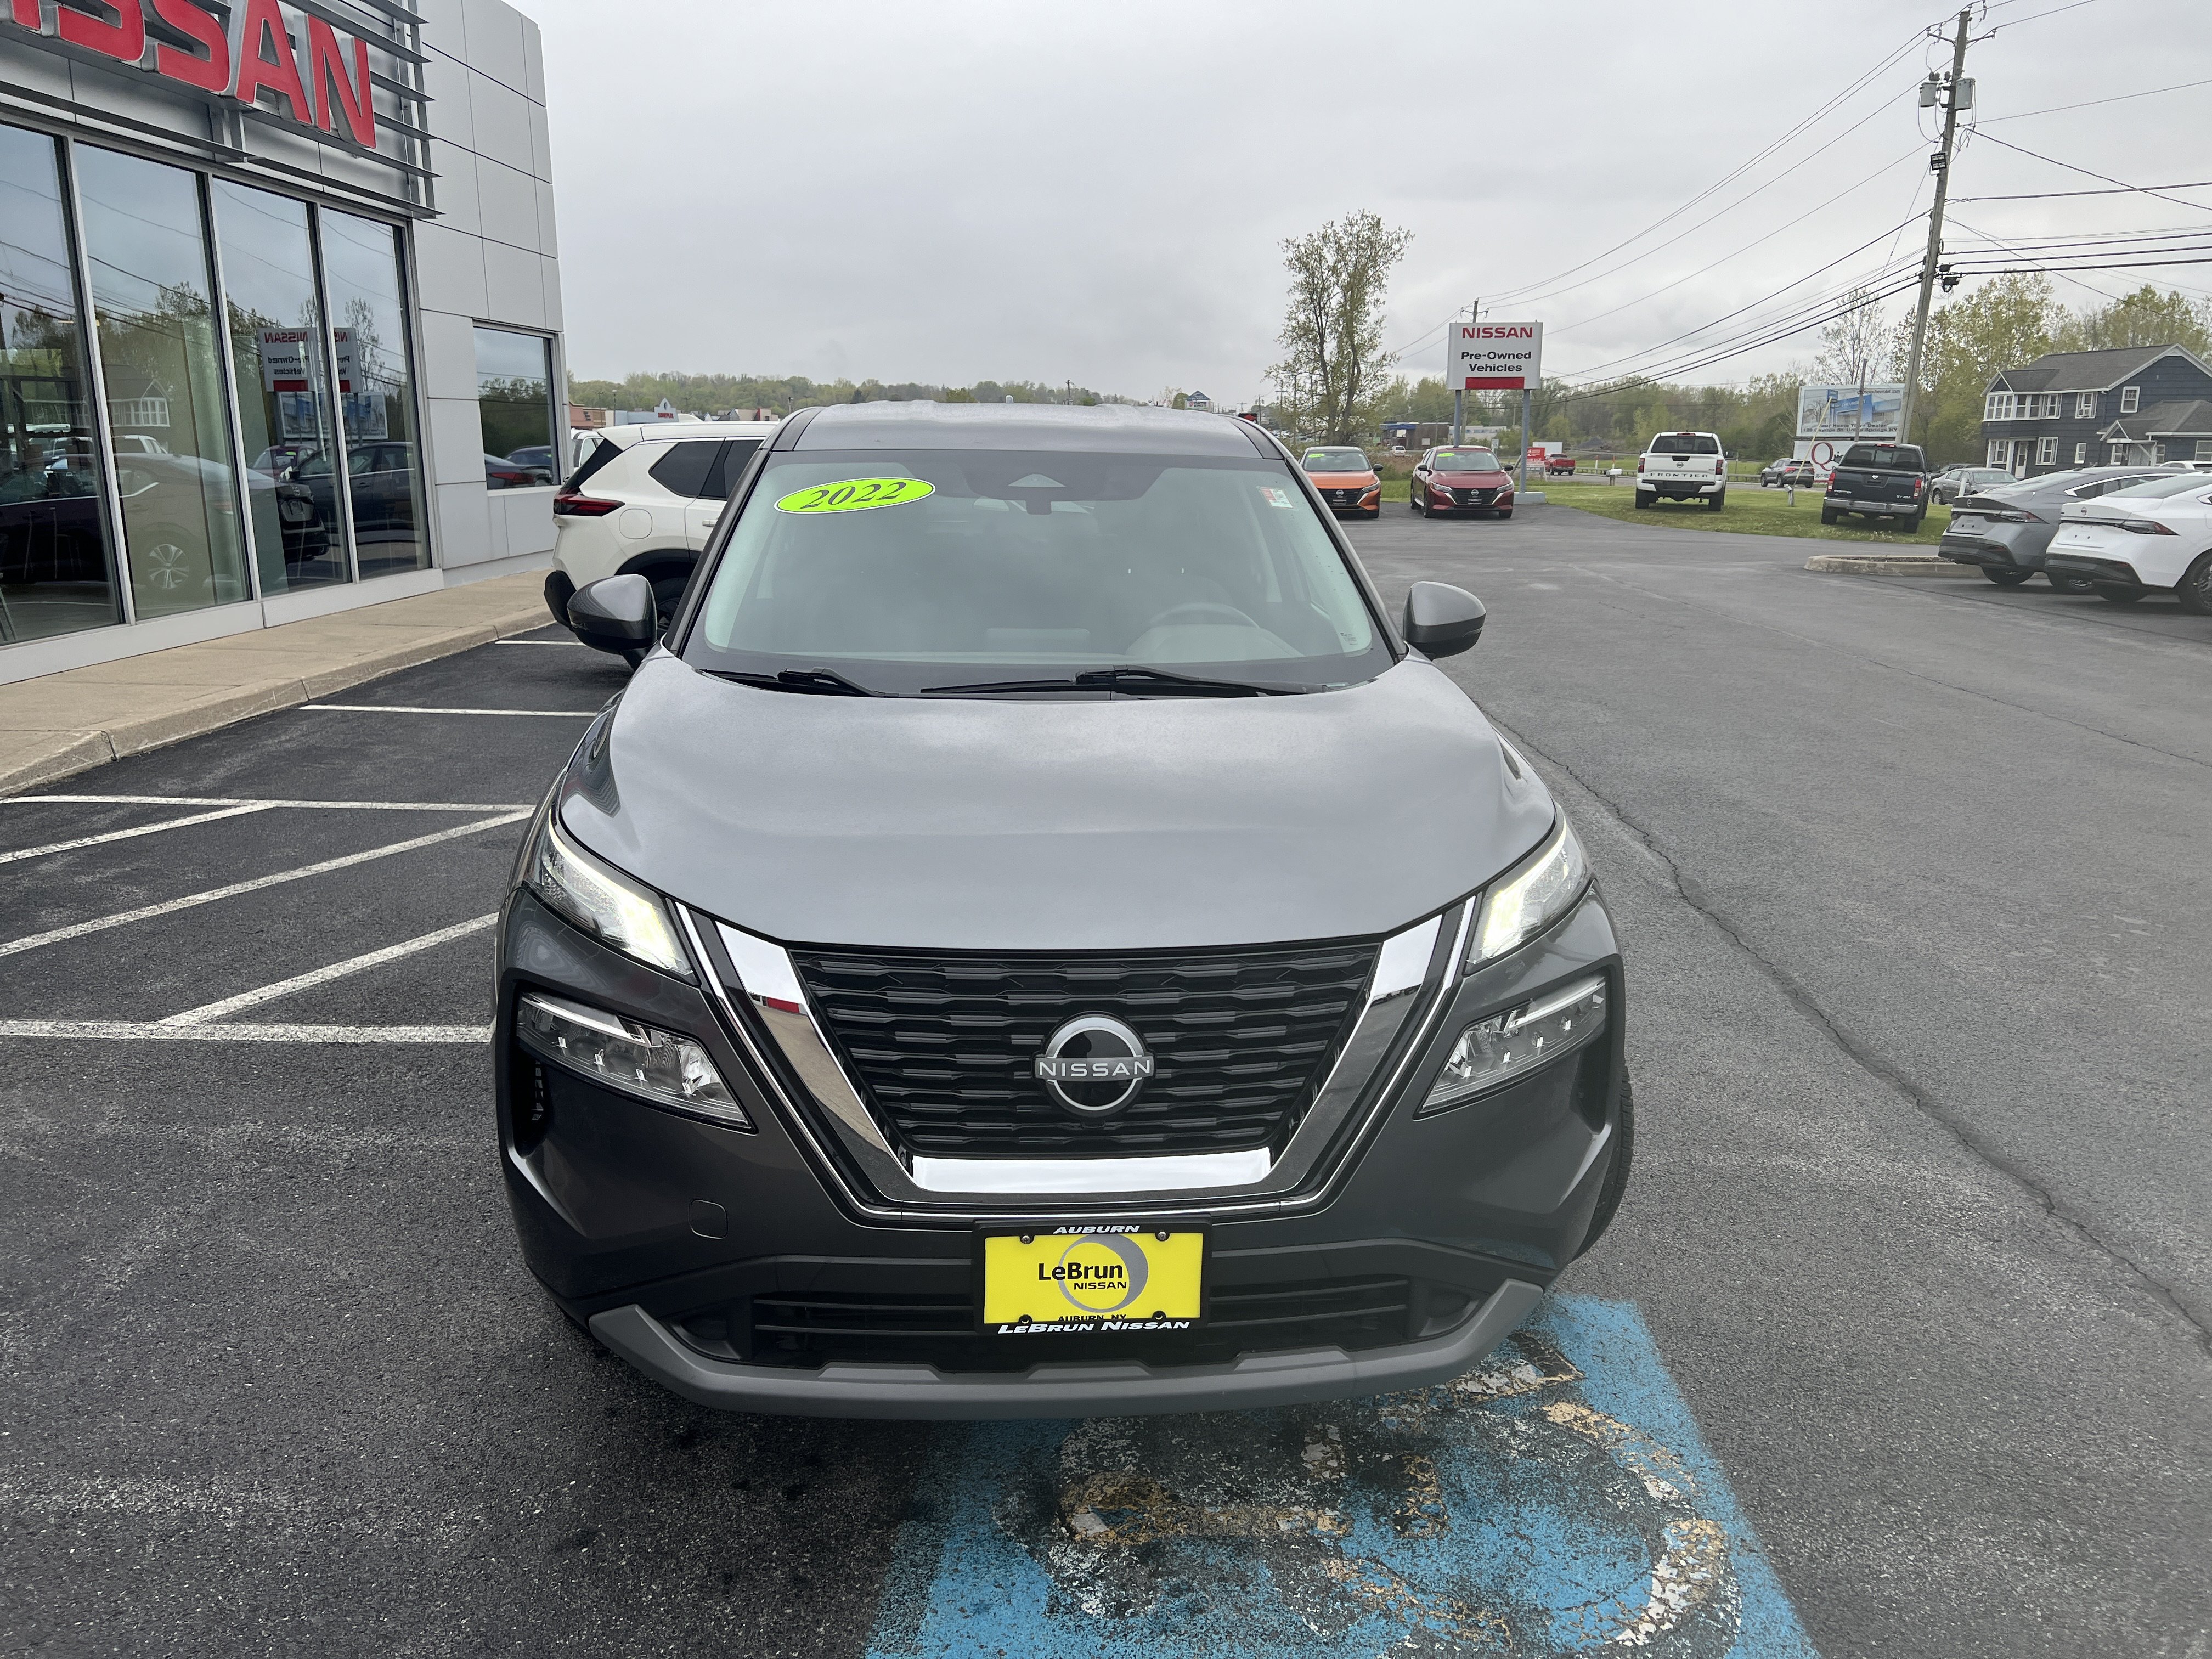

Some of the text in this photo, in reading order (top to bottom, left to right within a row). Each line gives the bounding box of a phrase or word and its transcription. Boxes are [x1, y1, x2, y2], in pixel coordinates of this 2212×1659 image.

[11, 0, 376, 149] SAN
[1462, 326, 1533, 338] NISSAN
[1461, 351, 1532, 359] Pre-Owned
[1469, 364, 1522, 372] Vehicles
[799, 482, 906, 509] 2022
[1039, 1060, 1150, 1077] NISSAN
[1053, 1225, 1141, 1234] AUBURN
[1039, 1262, 1123, 1280] LeBrun
[1074, 1282, 1127, 1290] NISSAN
